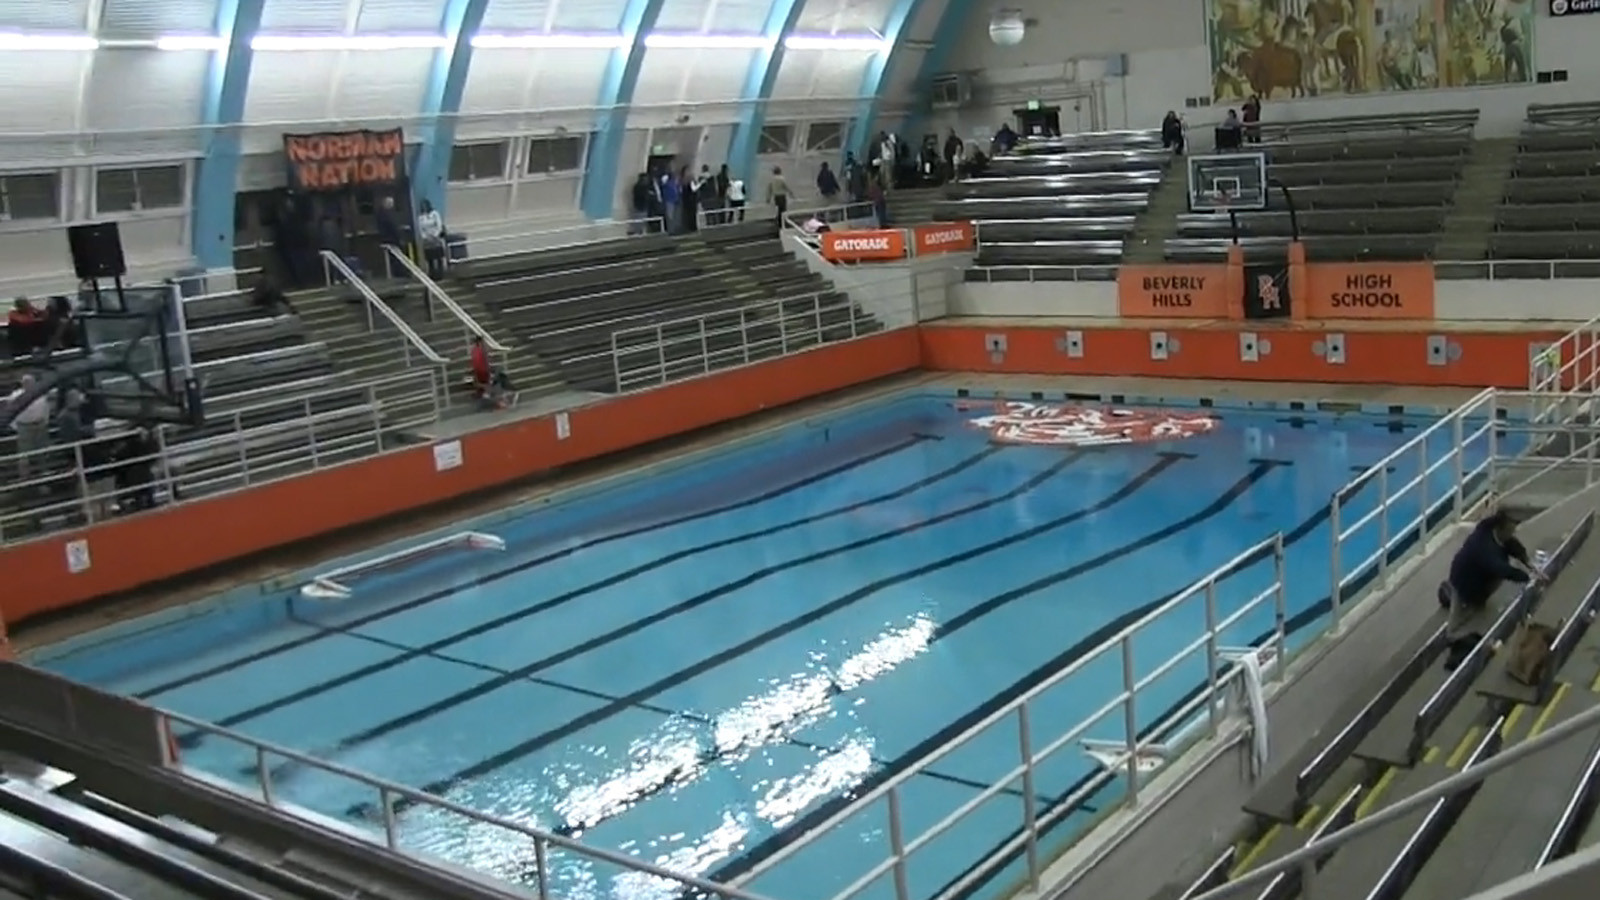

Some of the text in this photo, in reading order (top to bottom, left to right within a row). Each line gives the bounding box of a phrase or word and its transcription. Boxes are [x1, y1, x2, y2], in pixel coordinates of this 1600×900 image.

[288, 132, 400, 161] NORMAN
[300, 159, 396, 187] NATION
[833, 237, 889, 251] GATORADE
[924, 229, 964, 245] GATORADE
[1142, 275, 1206, 291] BEVERLY
[1346, 273, 1392, 289] HIGH
[1152, 293, 1192, 307] HILLS
[1331, 292, 1403, 308] SCHOOL
